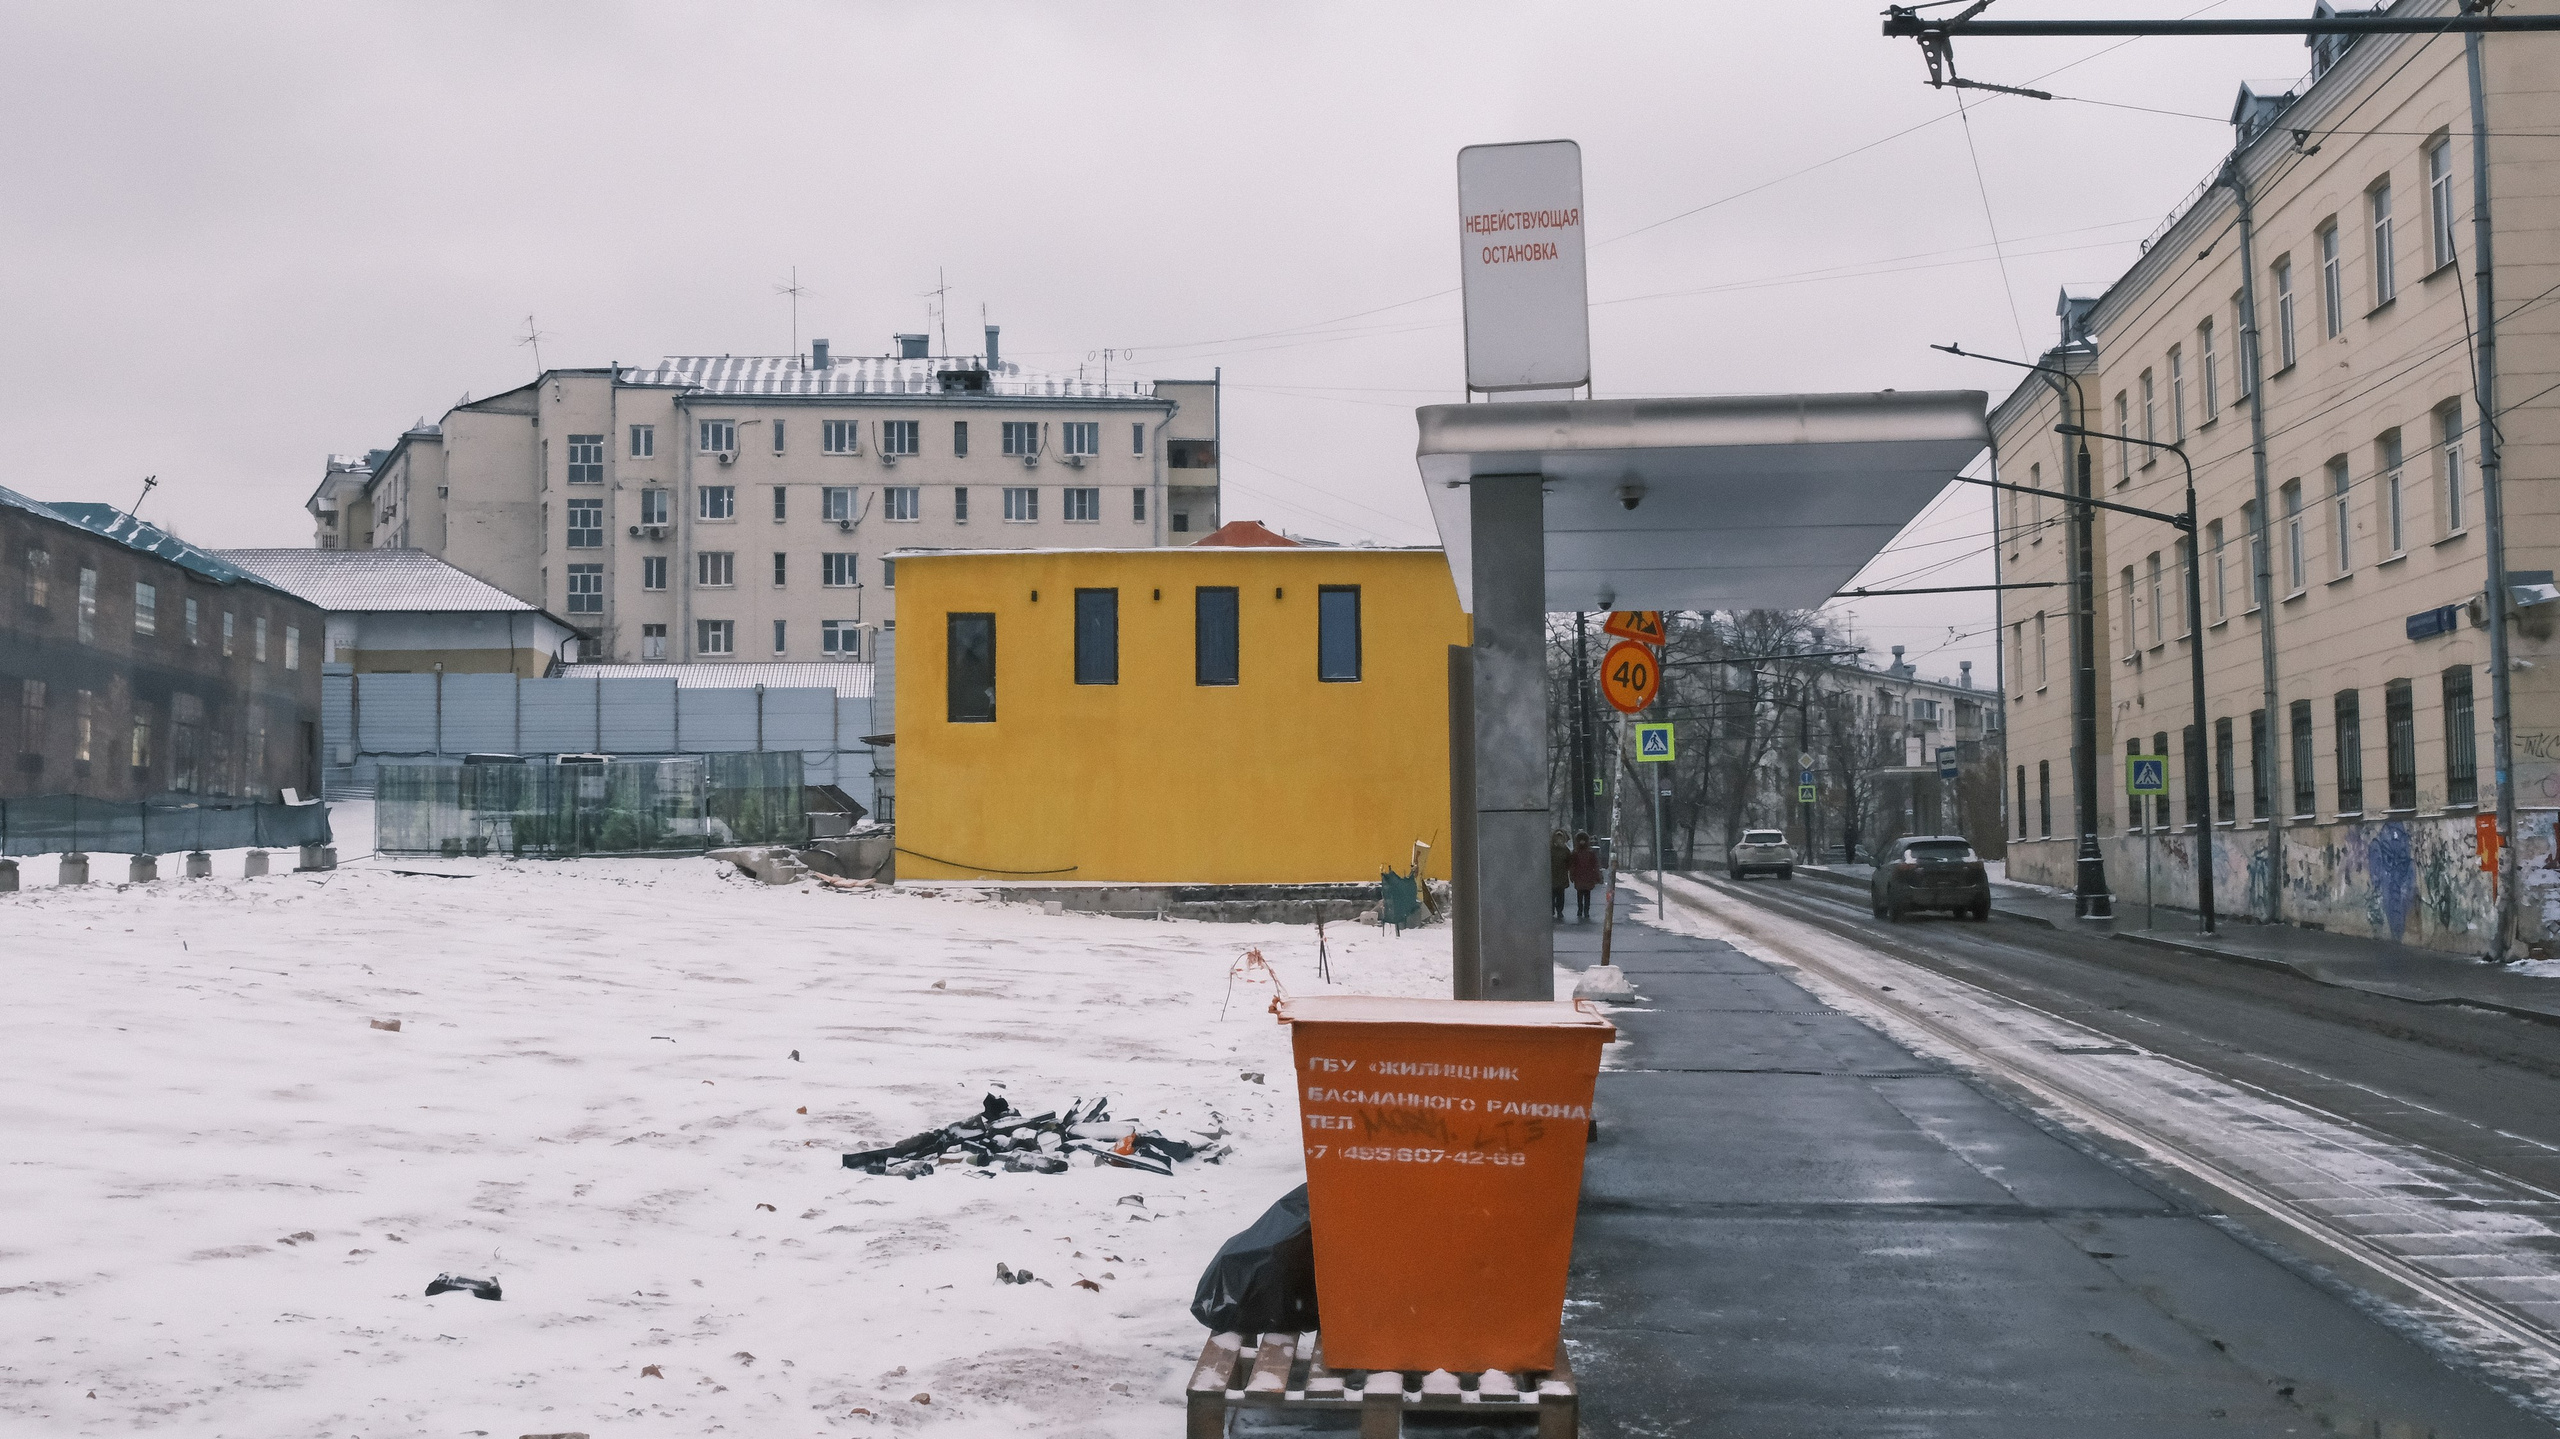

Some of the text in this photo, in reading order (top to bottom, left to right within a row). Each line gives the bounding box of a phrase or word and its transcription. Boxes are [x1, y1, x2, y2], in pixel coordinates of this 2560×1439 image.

[1466, 208, 1579, 235] НЕДЕЙСТВУЮЩАЯ
[1482, 242, 1559, 265] ОСТАНОВКА
[1612, 661, 1647, 691] 40
[1309, 1057, 1357, 1073] ГБУ
[1307, 1086, 1476, 1112] БАСМАННОГО
